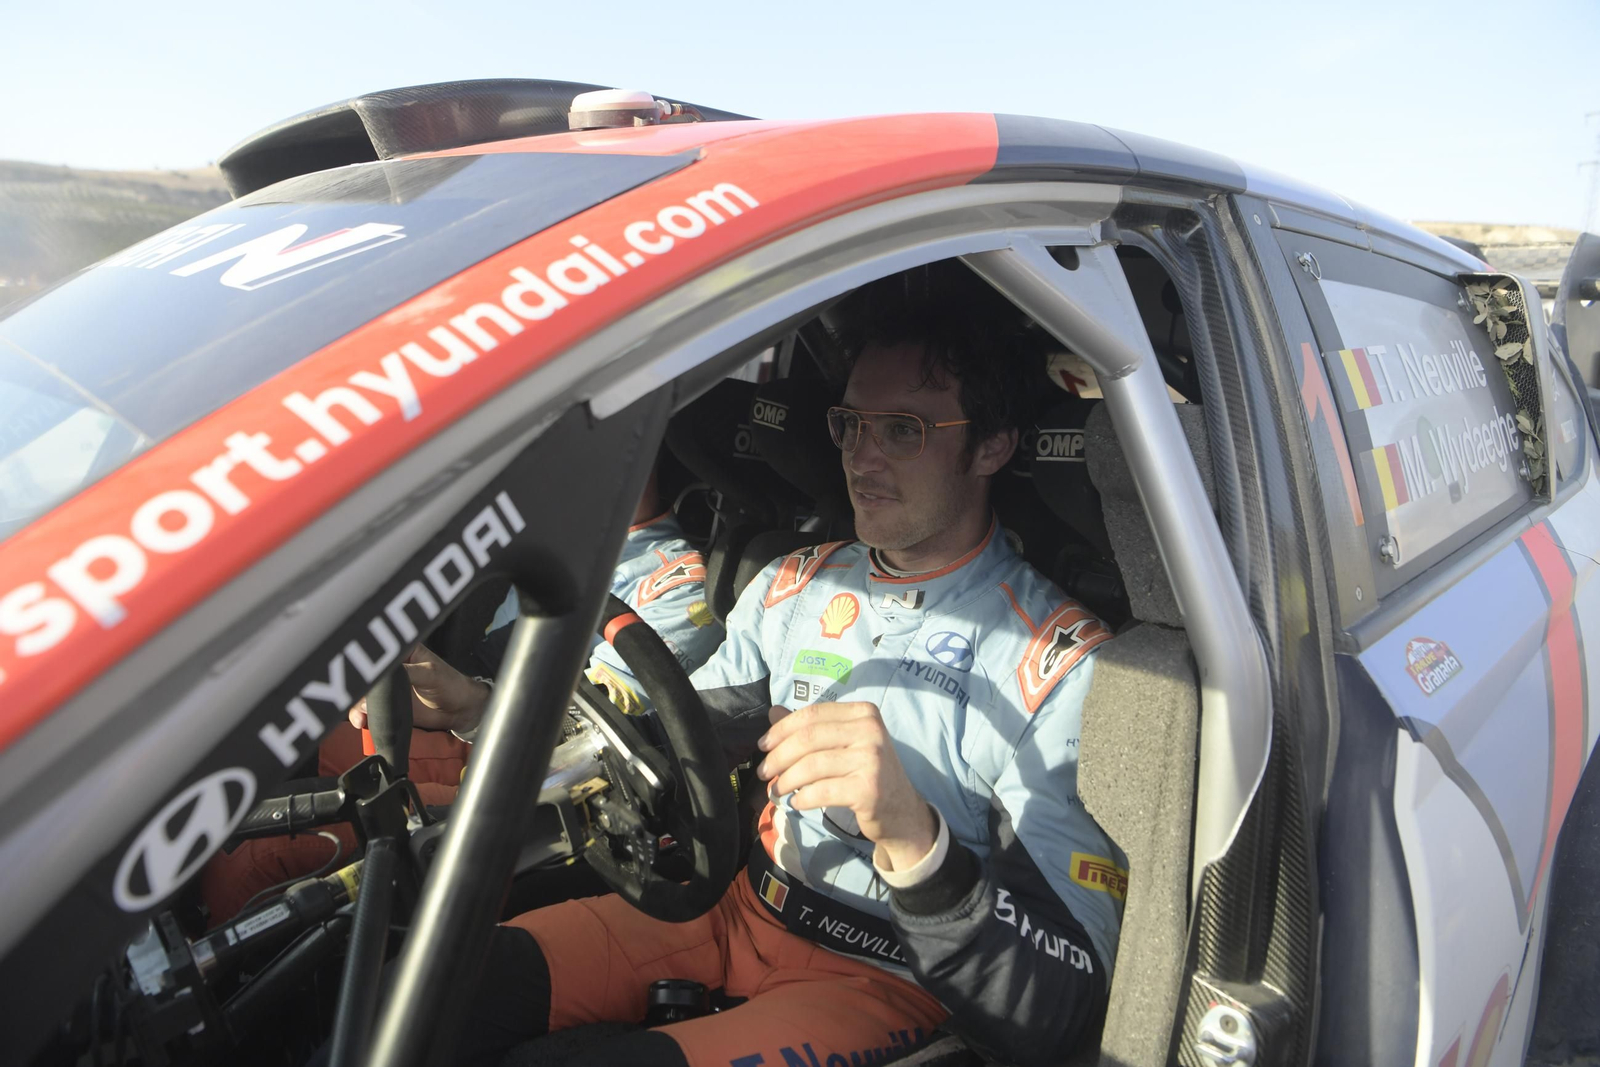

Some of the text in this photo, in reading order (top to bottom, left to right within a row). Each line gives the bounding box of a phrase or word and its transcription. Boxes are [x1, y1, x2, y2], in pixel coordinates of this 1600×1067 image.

[1366, 345, 1405, 403] T.
[1396, 340, 1487, 399] Neuville
[753, 402, 787, 425] OMP
[1301, 342, 1365, 526] 1
[1036, 433, 1084, 456] OMP
[1397, 406, 1519, 502] M. Wydaeghe
[257, 490, 527, 767] HYUNDAI
[799, 655, 827, 667] JOST
[899, 656, 971, 710] HYUNDAI
[1417, 654, 1459, 694] Granada
[799, 905, 907, 963] T. NEUVILL
